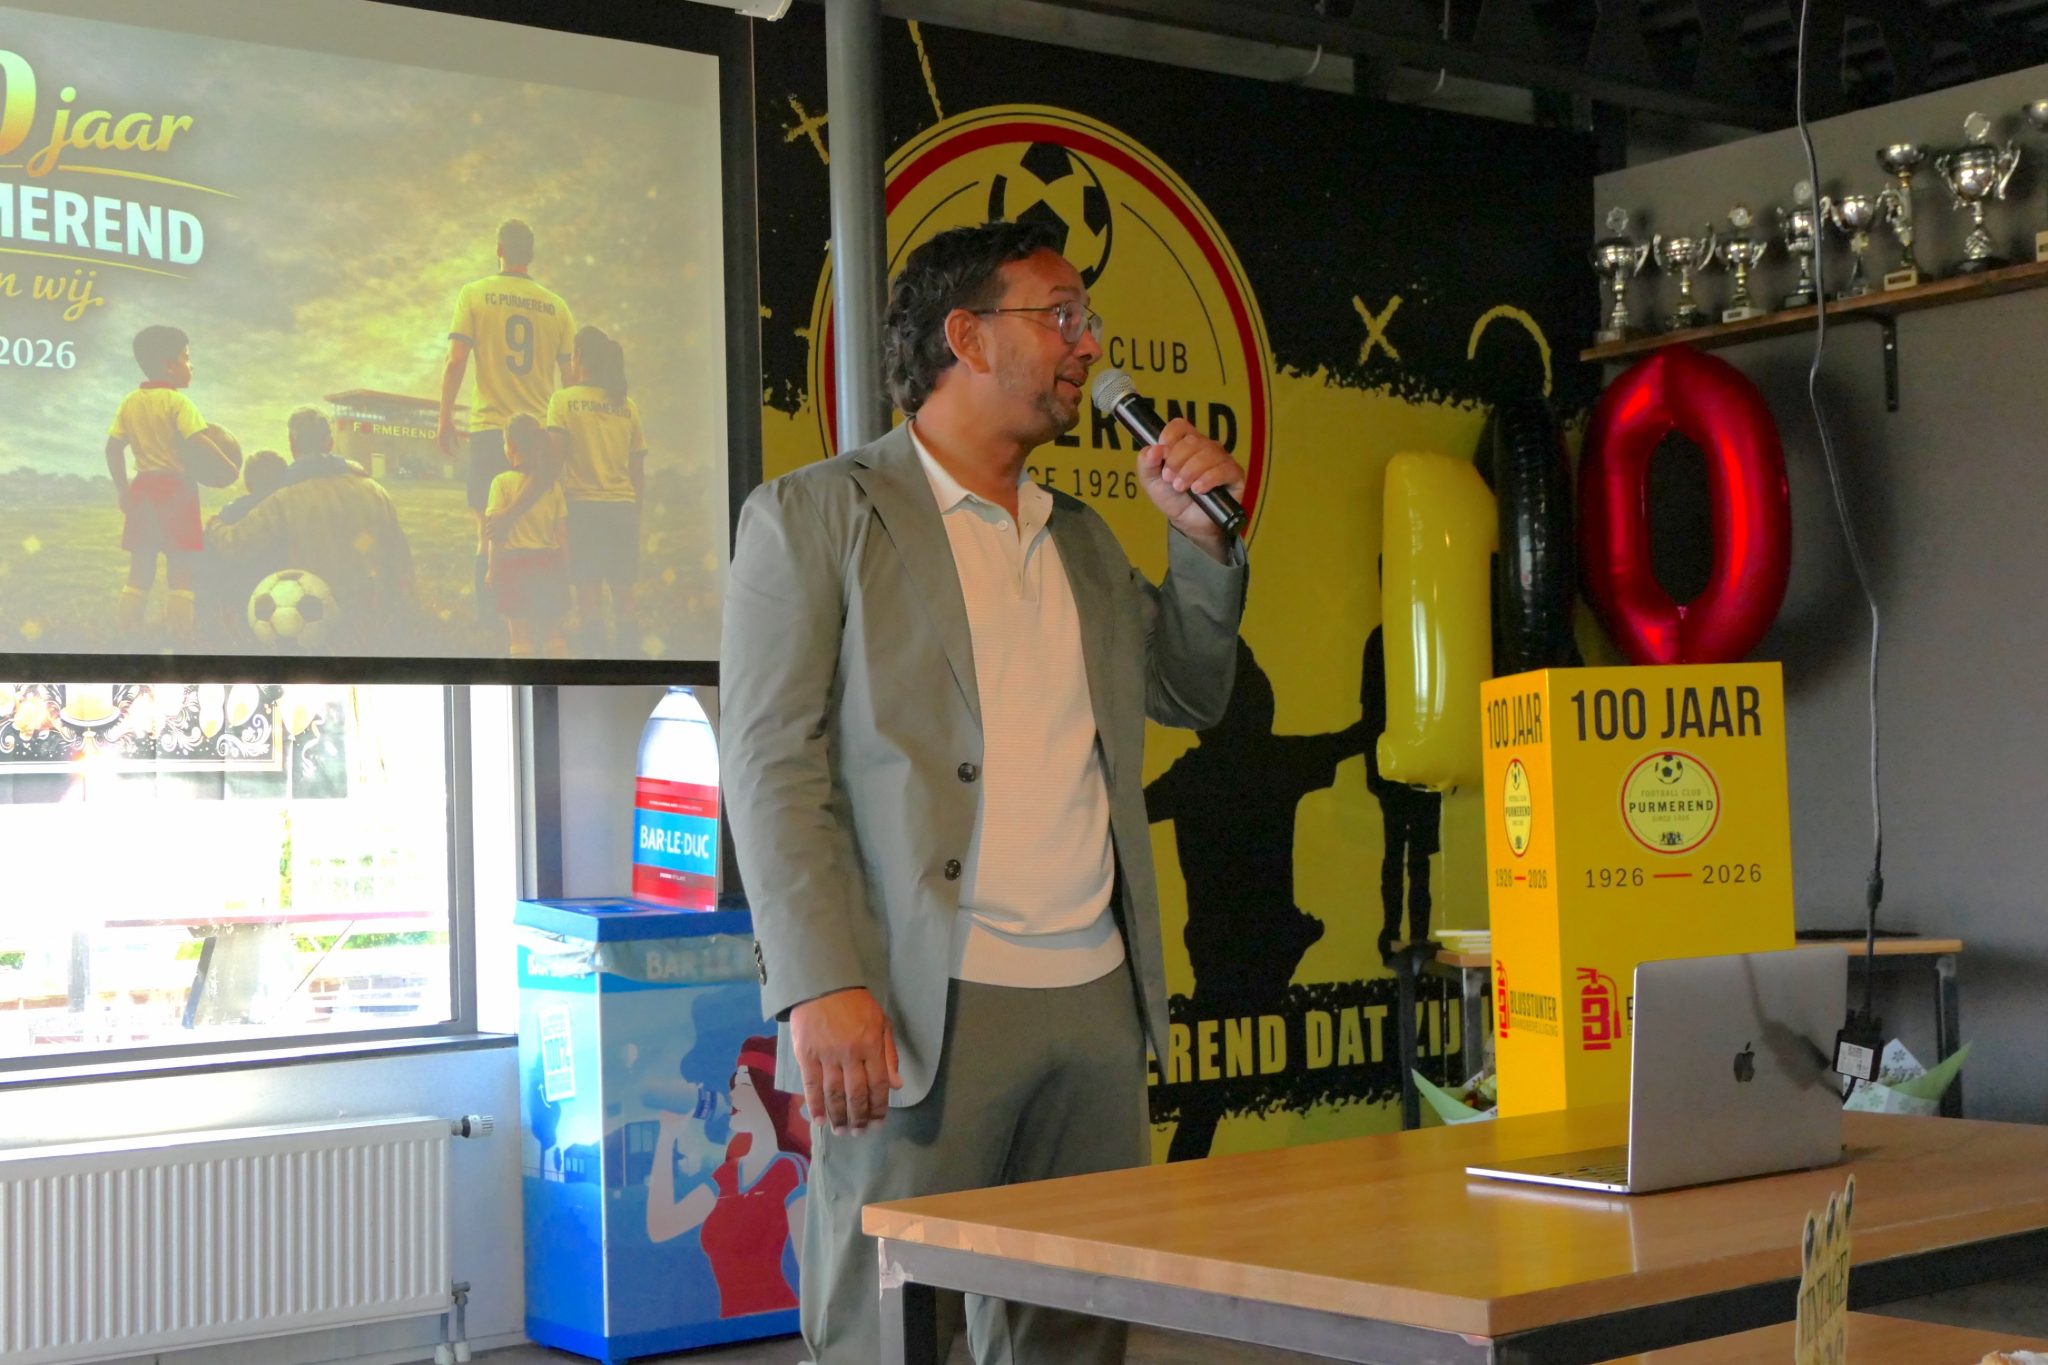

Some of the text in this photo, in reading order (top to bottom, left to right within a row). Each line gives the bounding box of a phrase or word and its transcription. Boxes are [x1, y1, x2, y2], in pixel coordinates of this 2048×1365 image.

[26, 86, 194, 177] jaar
[505, 313, 534, 376] 9
[1109, 336, 1189, 374] CLUB
[1072, 468, 1138, 499] 1926
[1487, 691, 1543, 750] 100 JAAR
[1570, 685, 1762, 742] 100 JAAR
[1629, 800, 1714, 813] PURMEREND
[1585, 863, 1762, 889] 1926 2026
[1304, 1004, 1388, 1070] DAT
